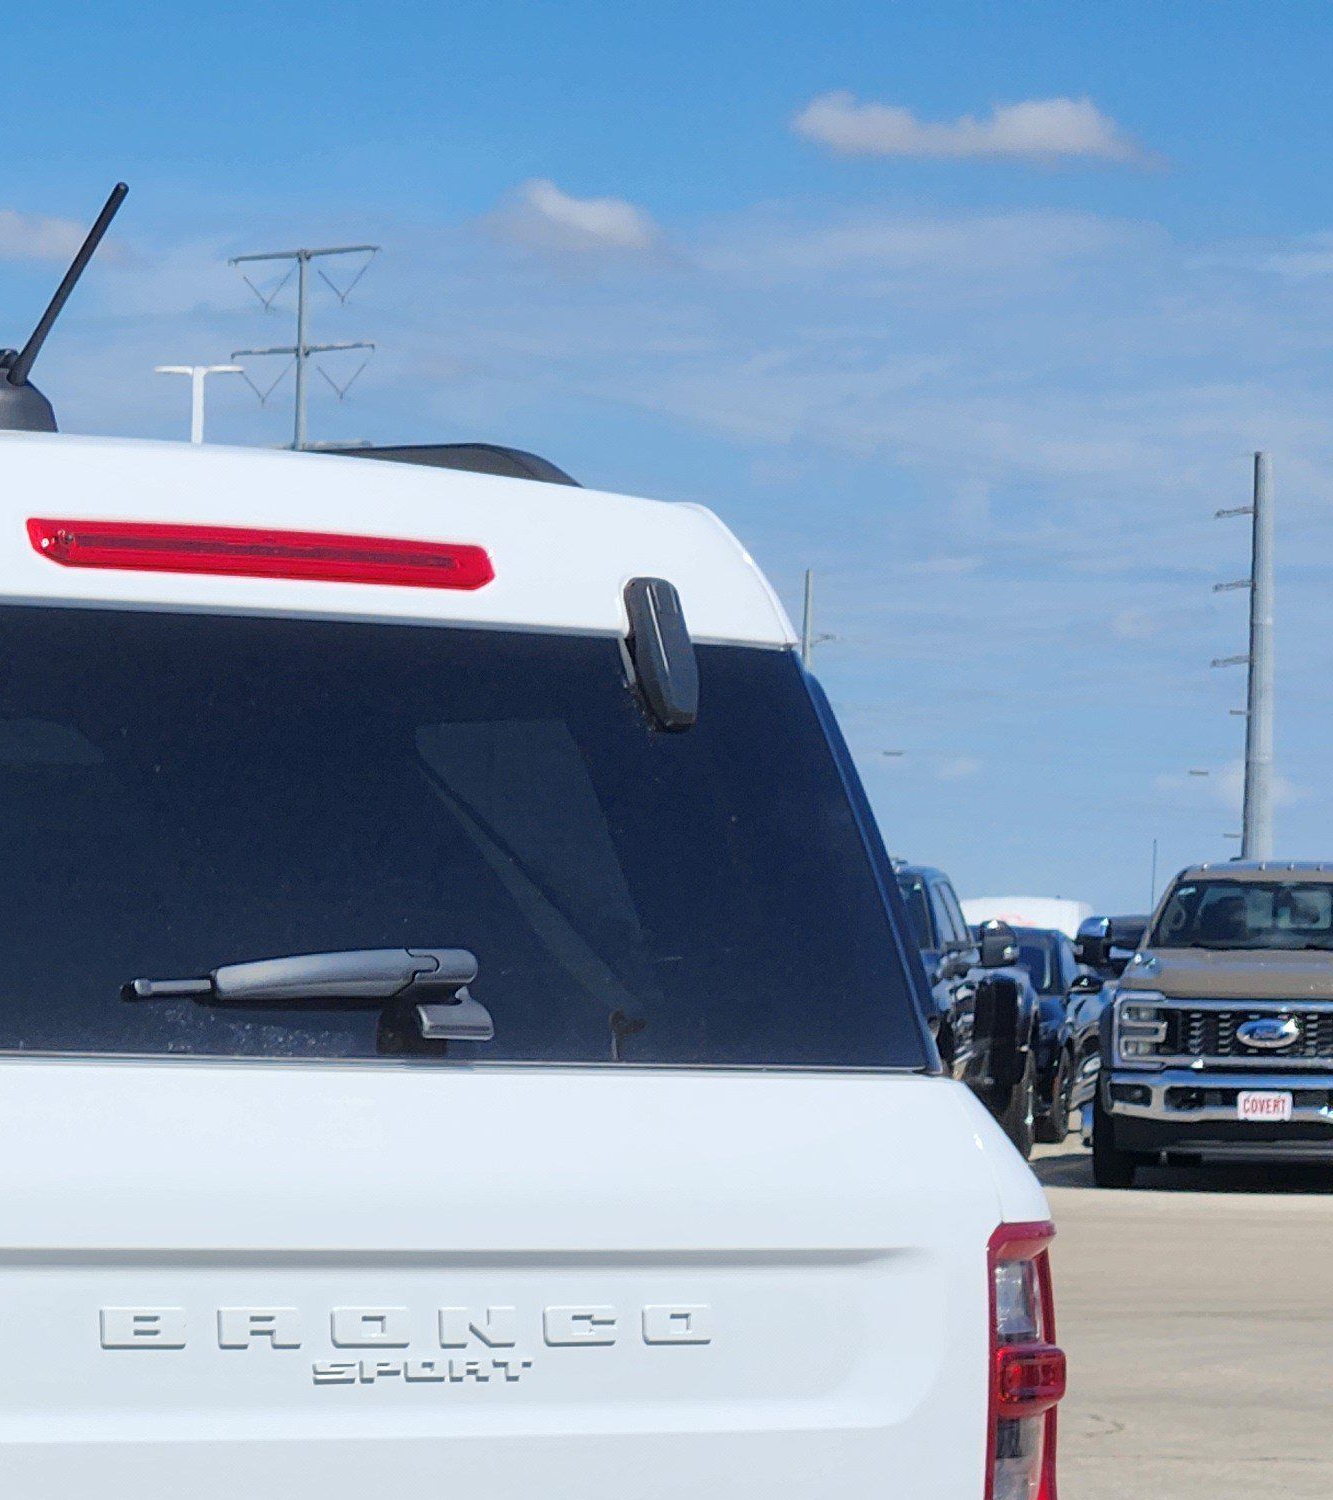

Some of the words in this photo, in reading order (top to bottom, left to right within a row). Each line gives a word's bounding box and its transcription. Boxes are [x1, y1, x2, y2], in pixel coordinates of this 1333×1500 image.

[1243, 1098, 1286, 1114] COVERT
[99, 1304, 712, 1350] BRONCO
[311, 1358, 533, 1385] SPORT
